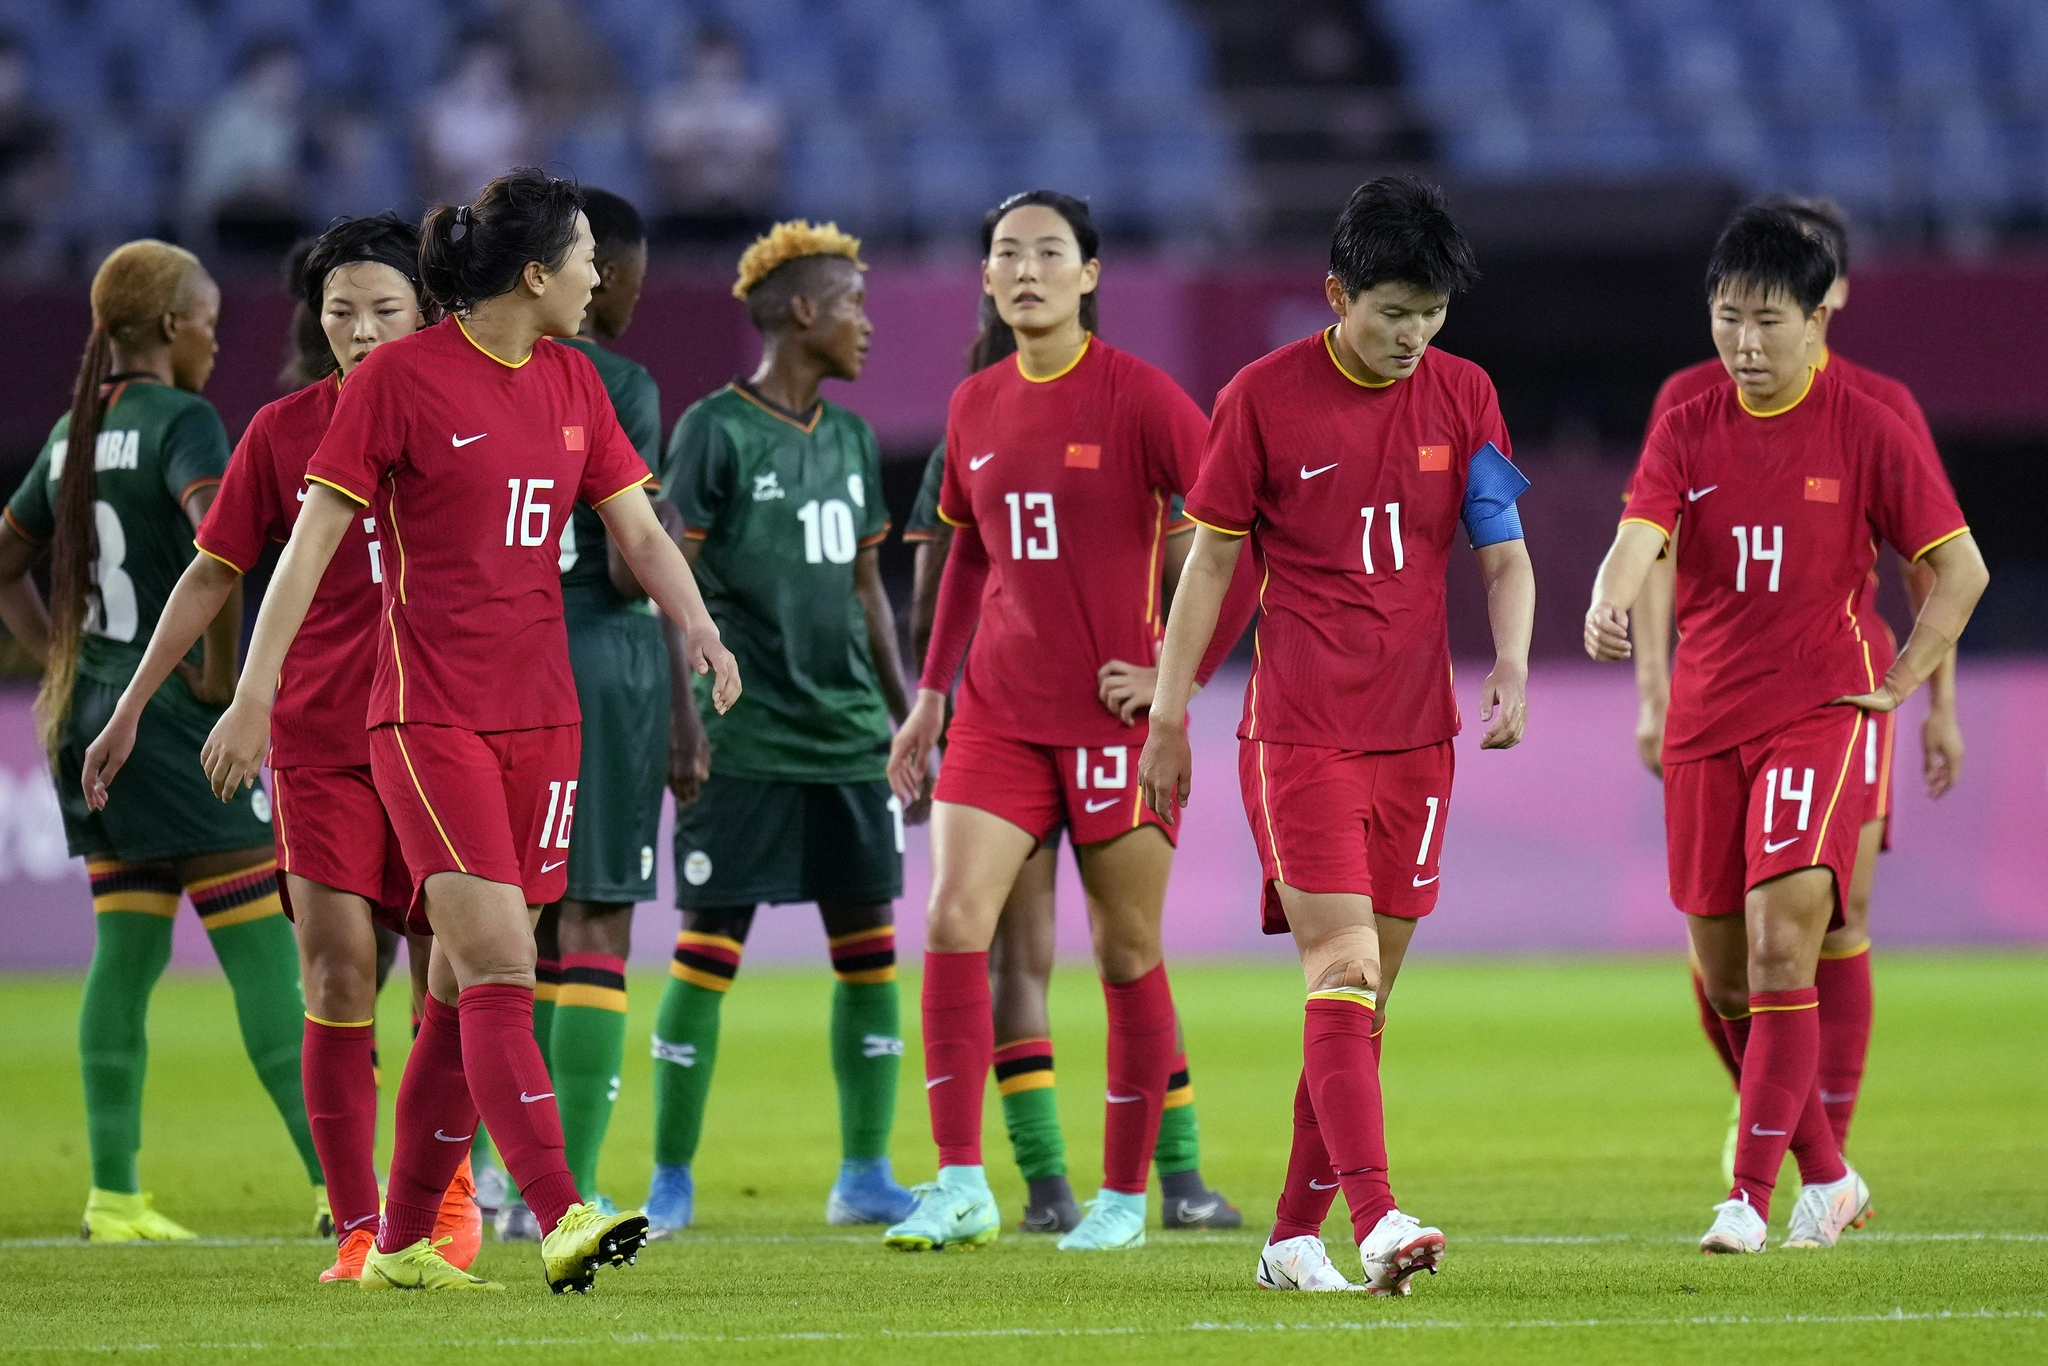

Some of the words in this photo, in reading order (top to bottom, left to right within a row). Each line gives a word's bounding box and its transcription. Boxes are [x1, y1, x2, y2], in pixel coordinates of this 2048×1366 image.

[505, 478, 555, 546] 16
[797, 499, 857, 564] 10
[1004, 492, 1059, 560] 13
[1361, 502, 1404, 575] 11
[1732, 526, 1783, 592] 14
[1076, 745, 1127, 790] 13
[1764, 767, 1815, 833] 14
[1416, 796, 1448, 867] 1
